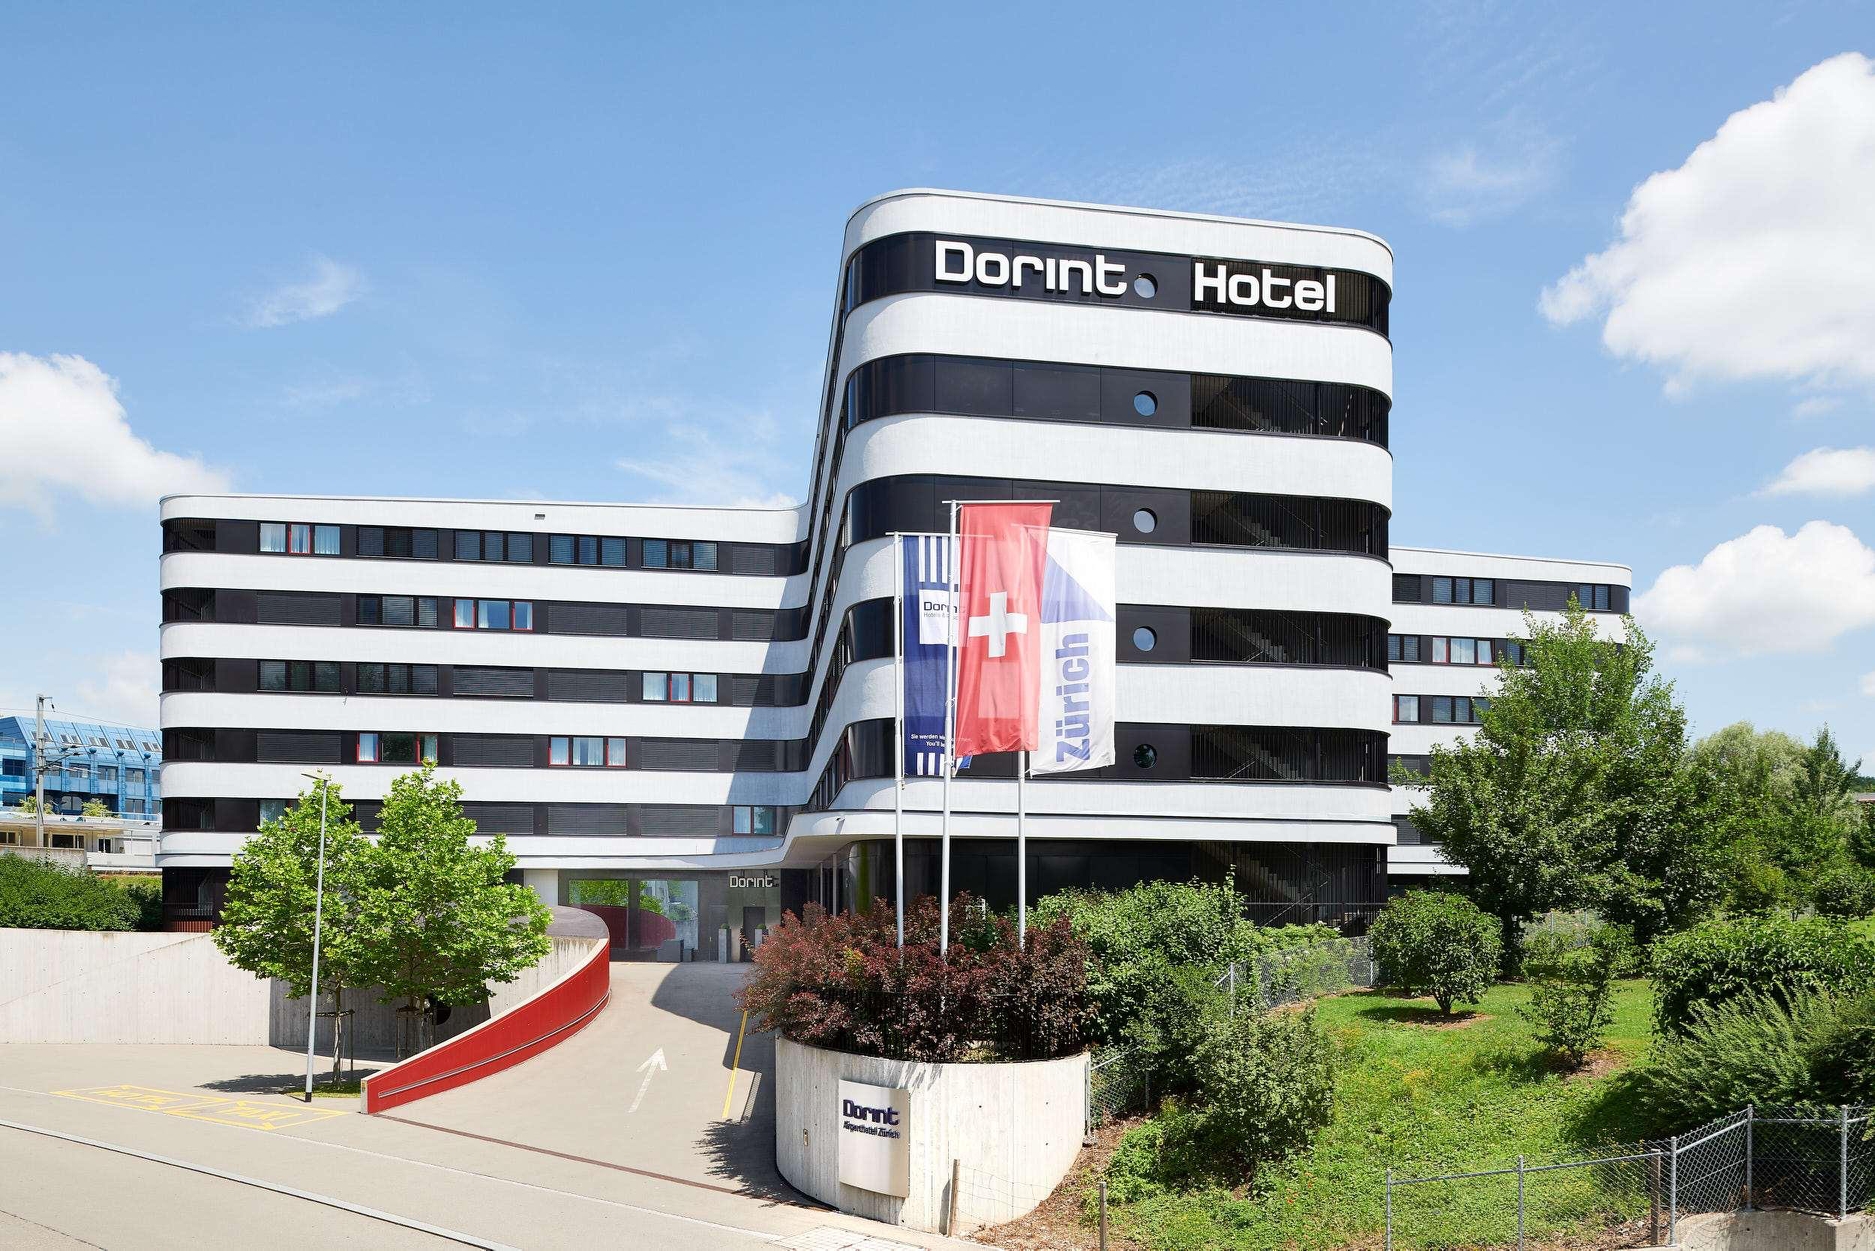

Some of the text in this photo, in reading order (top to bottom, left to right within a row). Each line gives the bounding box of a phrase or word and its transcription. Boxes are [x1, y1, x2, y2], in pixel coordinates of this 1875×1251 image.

[935, 240, 1336, 314] Dorint Hotel
[1056, 633, 1091, 762] Zürich
[729, 875, 773, 888] Dorint
[843, 1099, 899, 1125] Dorint
